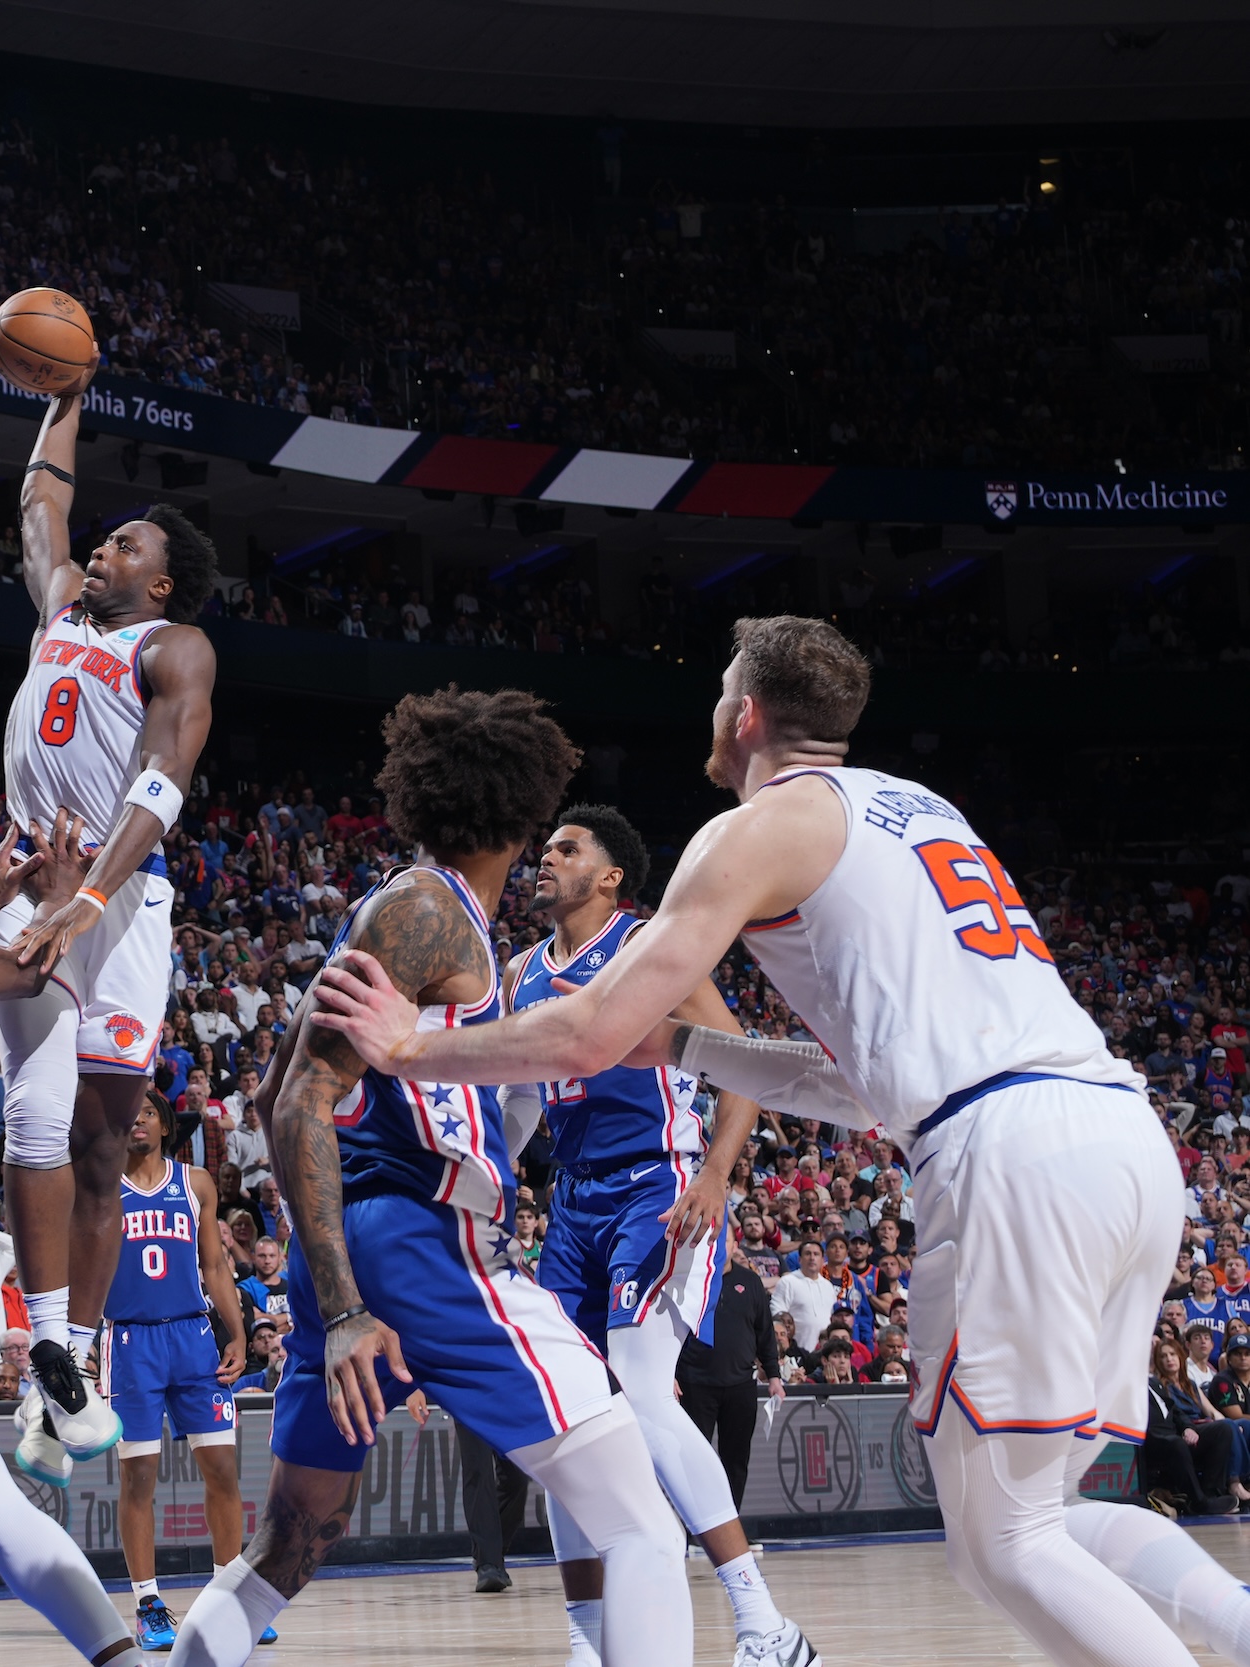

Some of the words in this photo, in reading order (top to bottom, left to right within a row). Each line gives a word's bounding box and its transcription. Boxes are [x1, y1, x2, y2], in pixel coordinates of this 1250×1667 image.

[132, 396, 194, 432] 76ers
[1027, 482, 1091, 510] Penn
[1096, 480, 1228, 510] Medicine
[38, 676, 81, 748] 8
[147, 781, 162, 796] 8
[910, 838, 1057, 968] 55
[141, 1244, 167, 1280] 0
[612, 1280, 639, 1312] 76
[213, 1401, 234, 1422] 76
[868, 1442, 884, 1469] VS
